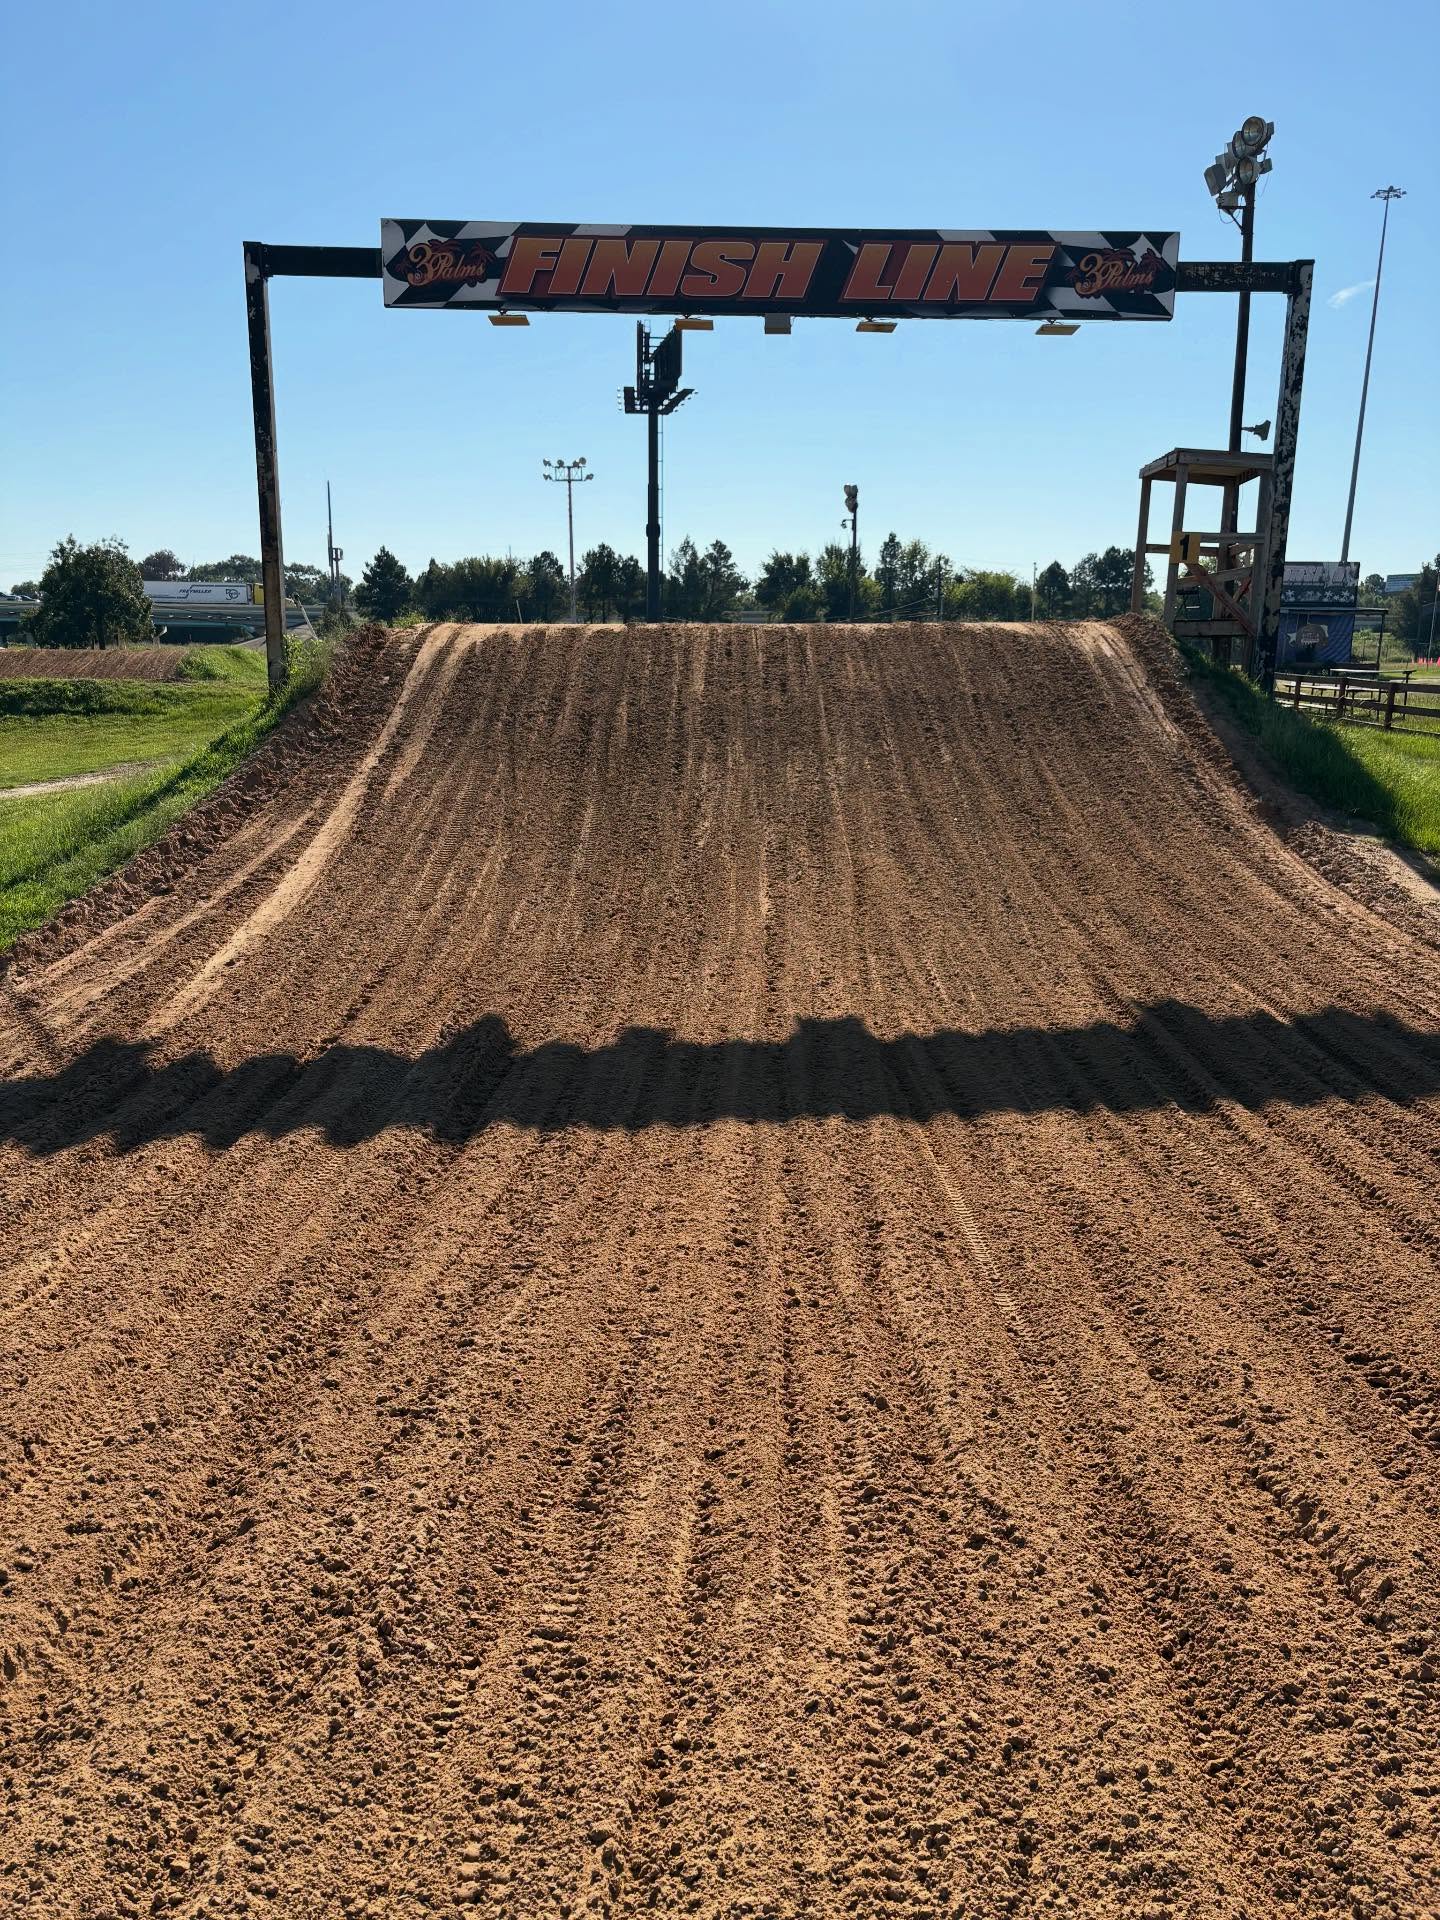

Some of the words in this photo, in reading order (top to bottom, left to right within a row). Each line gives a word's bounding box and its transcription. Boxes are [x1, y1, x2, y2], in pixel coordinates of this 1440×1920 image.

[407, 243, 434, 287] 3
[430, 253, 485, 280] Palms
[500, 236, 825, 299] FINISH
[843, 242, 1056, 301] LINE
[1076, 253, 1103, 295] 3
[1100, 261, 1153, 288] Palms
[1180, 534, 1190, 560] 1
